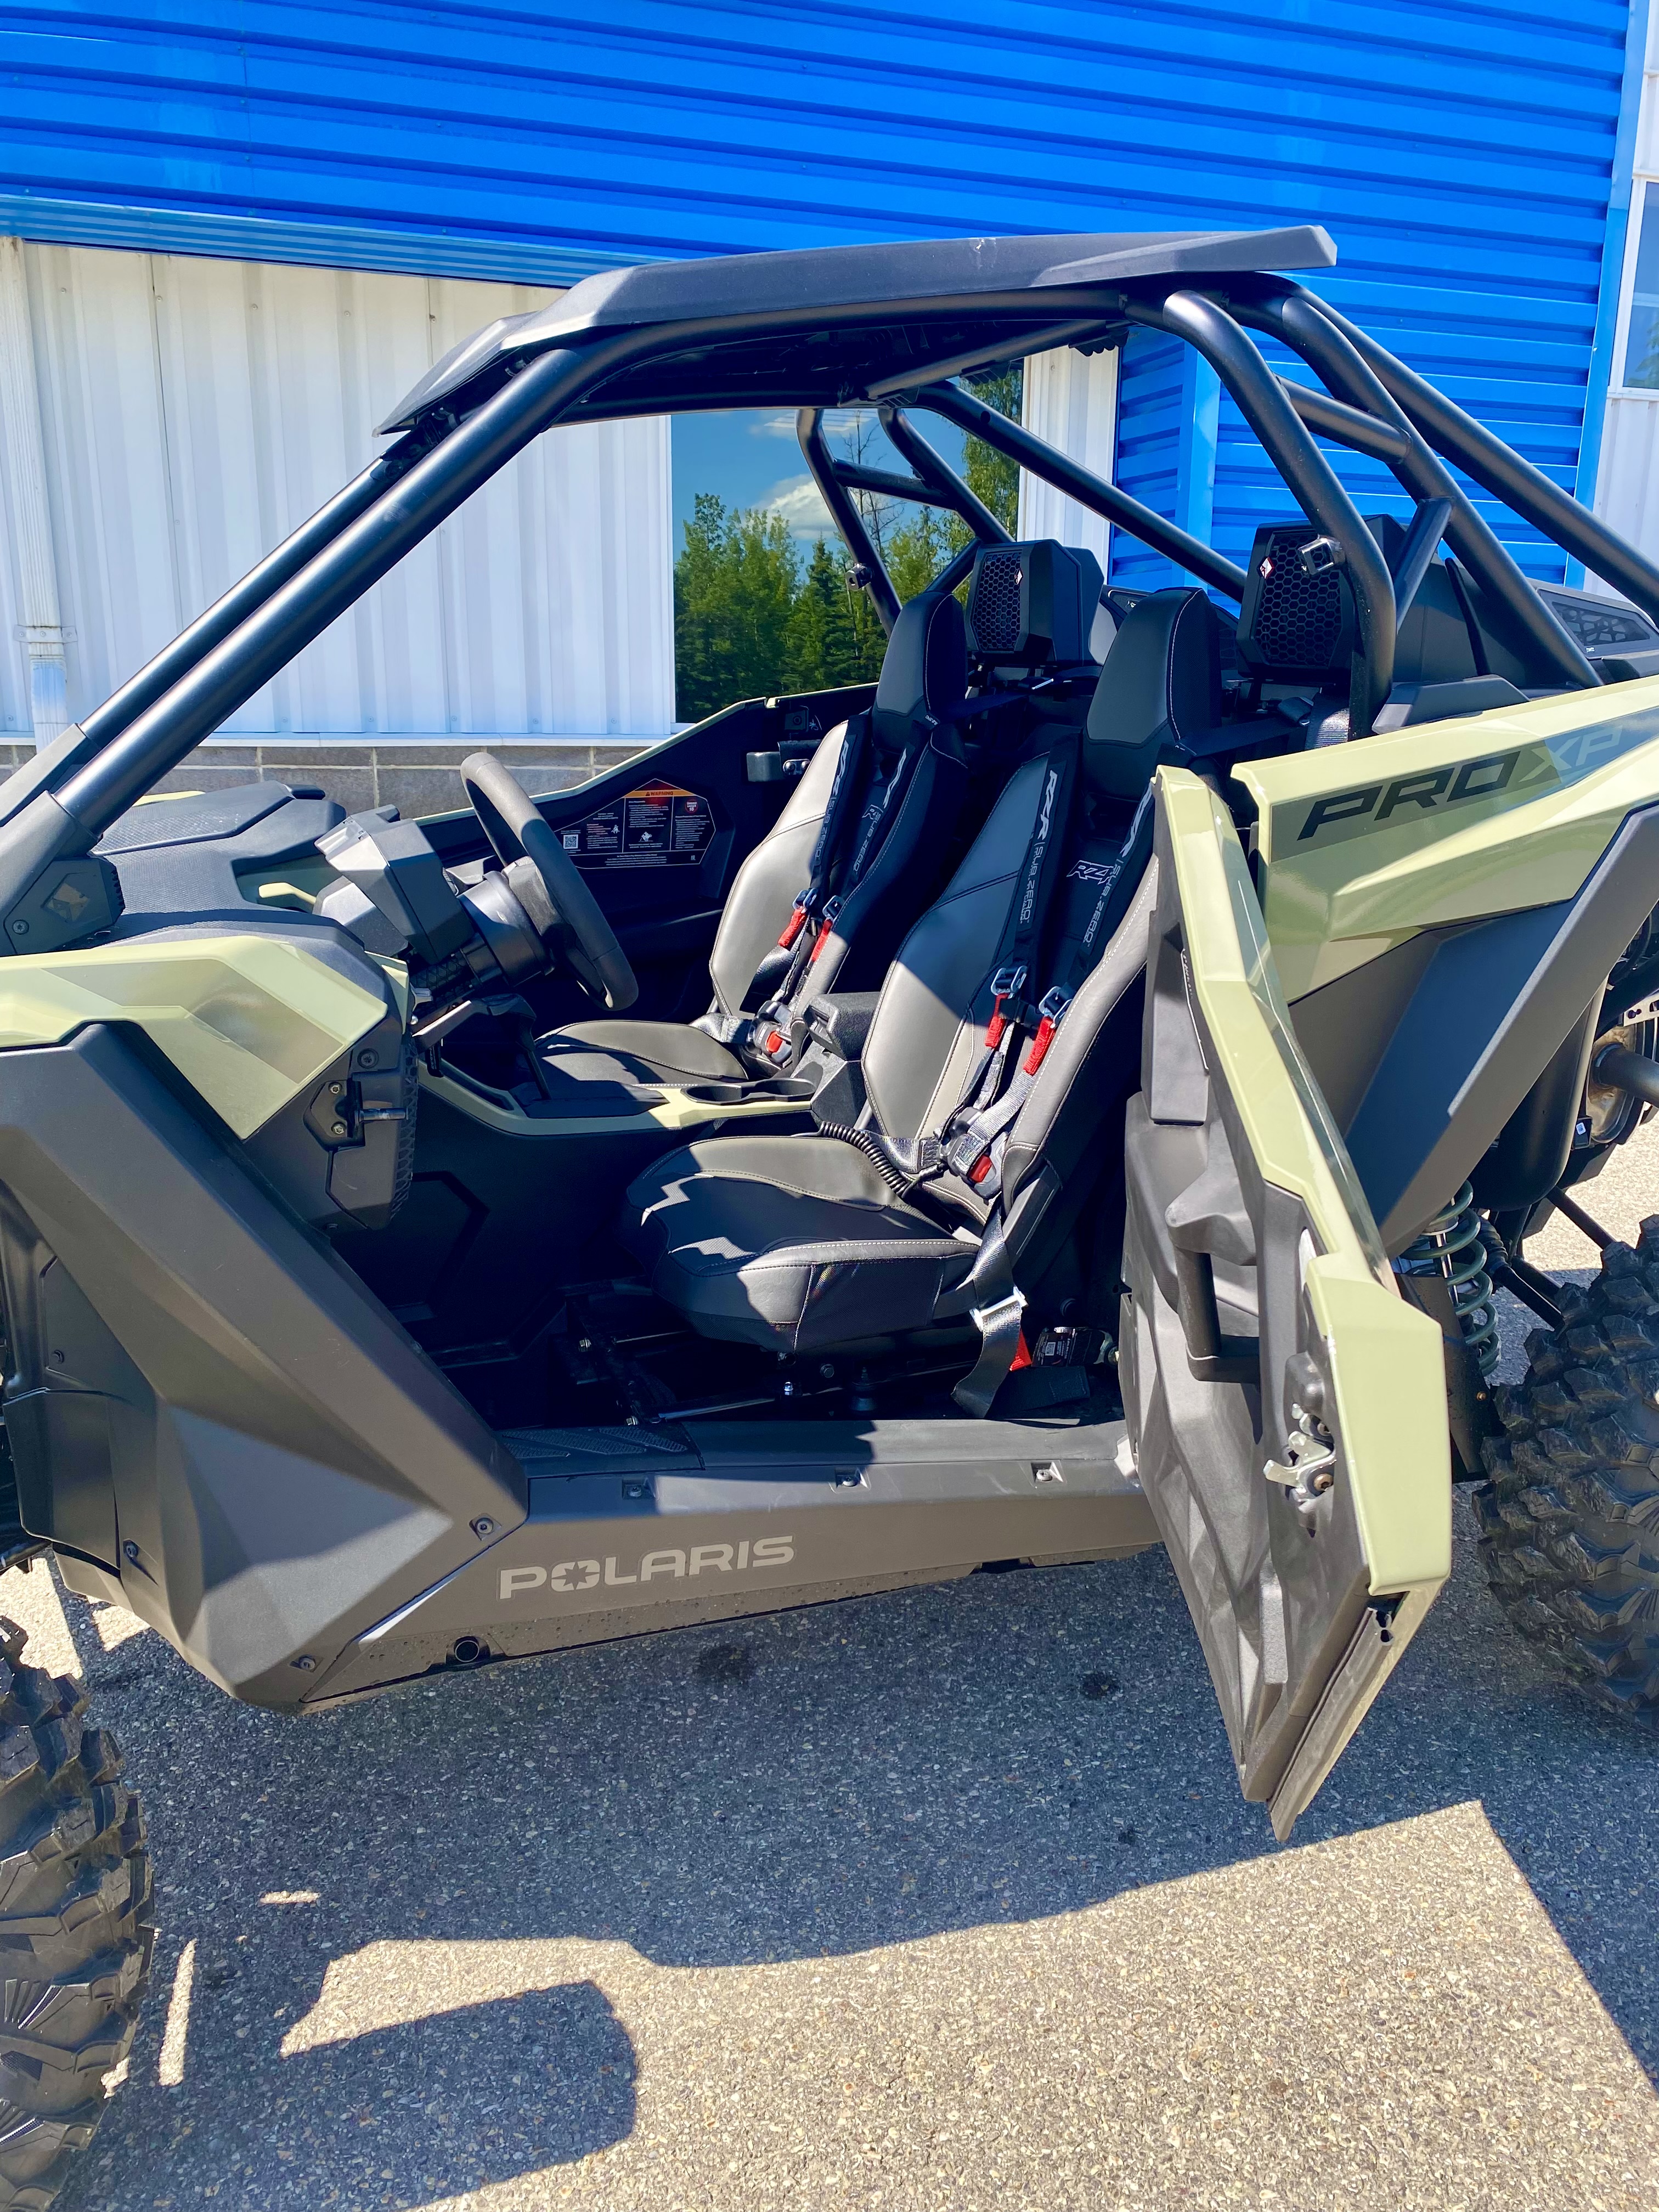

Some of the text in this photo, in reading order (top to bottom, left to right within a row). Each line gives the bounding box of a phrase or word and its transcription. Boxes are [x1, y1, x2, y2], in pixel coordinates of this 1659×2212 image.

[1037, 770, 1058, 840] RZR
[1024, 879, 1035, 921] ZERO
[1083, 901, 1104, 943] ZERO
[499, 1536, 795, 1600] POLARIS
